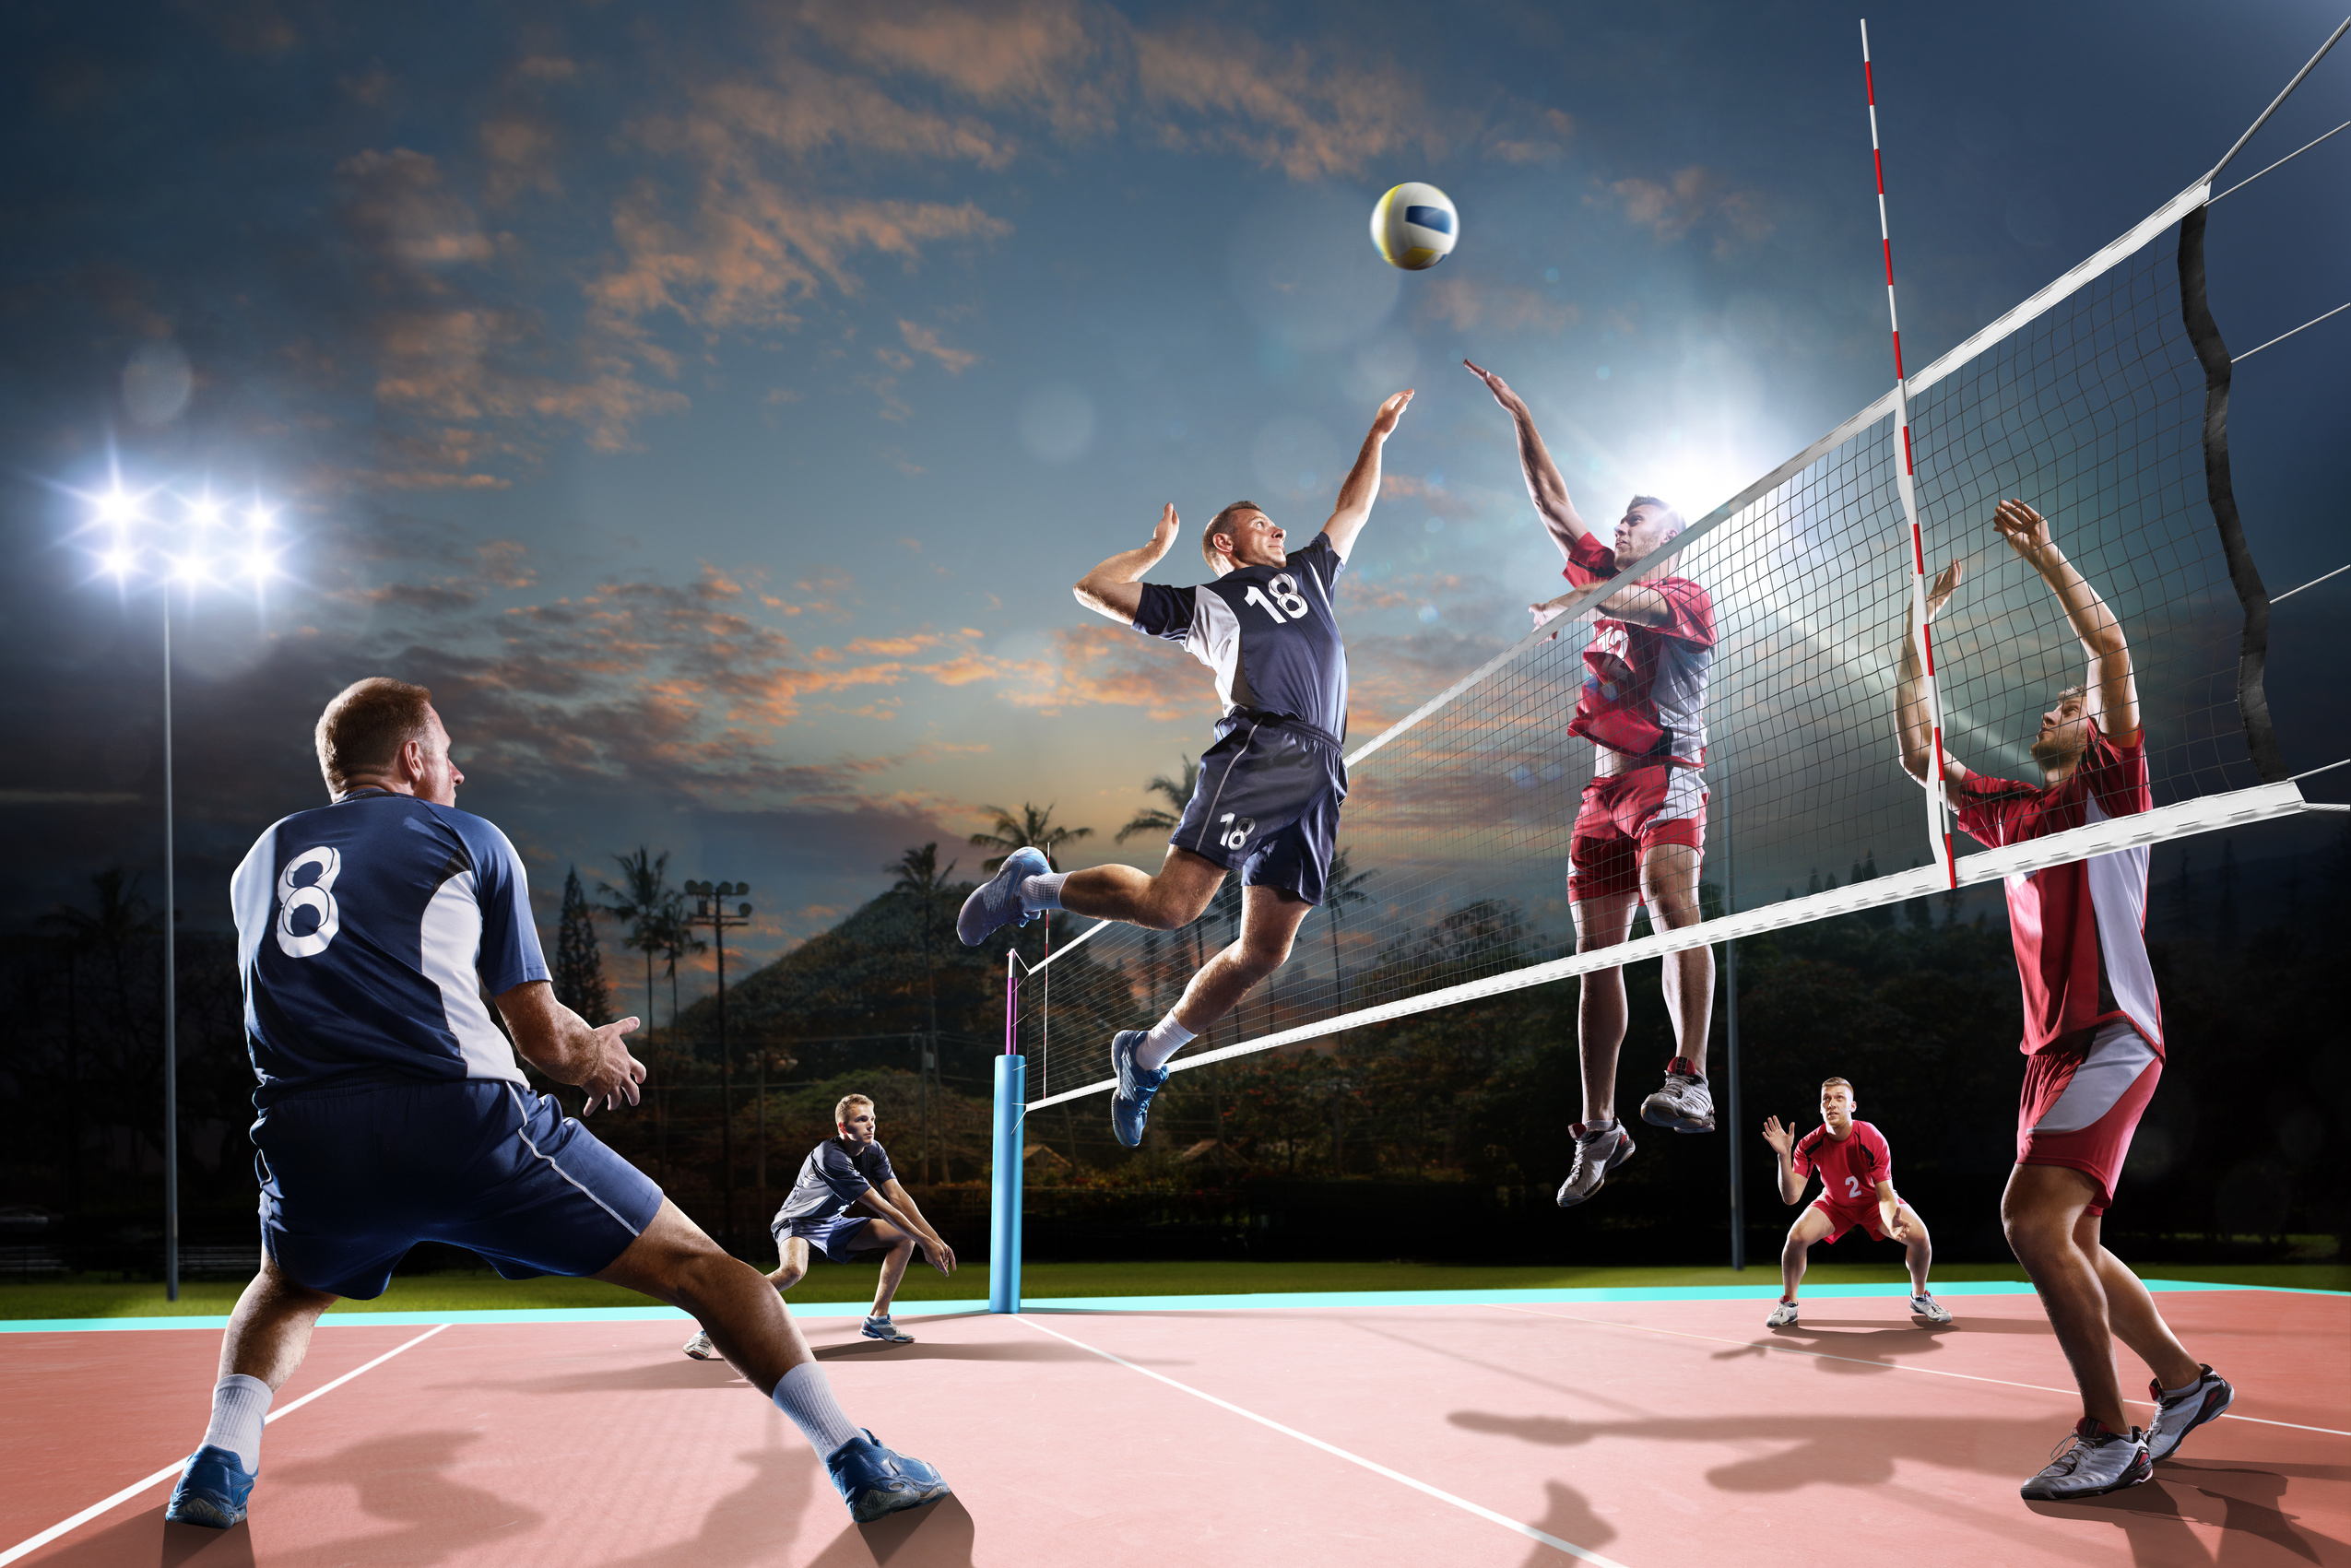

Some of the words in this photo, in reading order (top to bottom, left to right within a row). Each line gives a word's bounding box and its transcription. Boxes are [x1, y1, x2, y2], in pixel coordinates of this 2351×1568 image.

[1244, 572, 1308, 624] 18
[1220, 812, 1256, 851] 18
[277, 845, 341, 959] 8
[1845, 1175, 1862, 1198] 2
